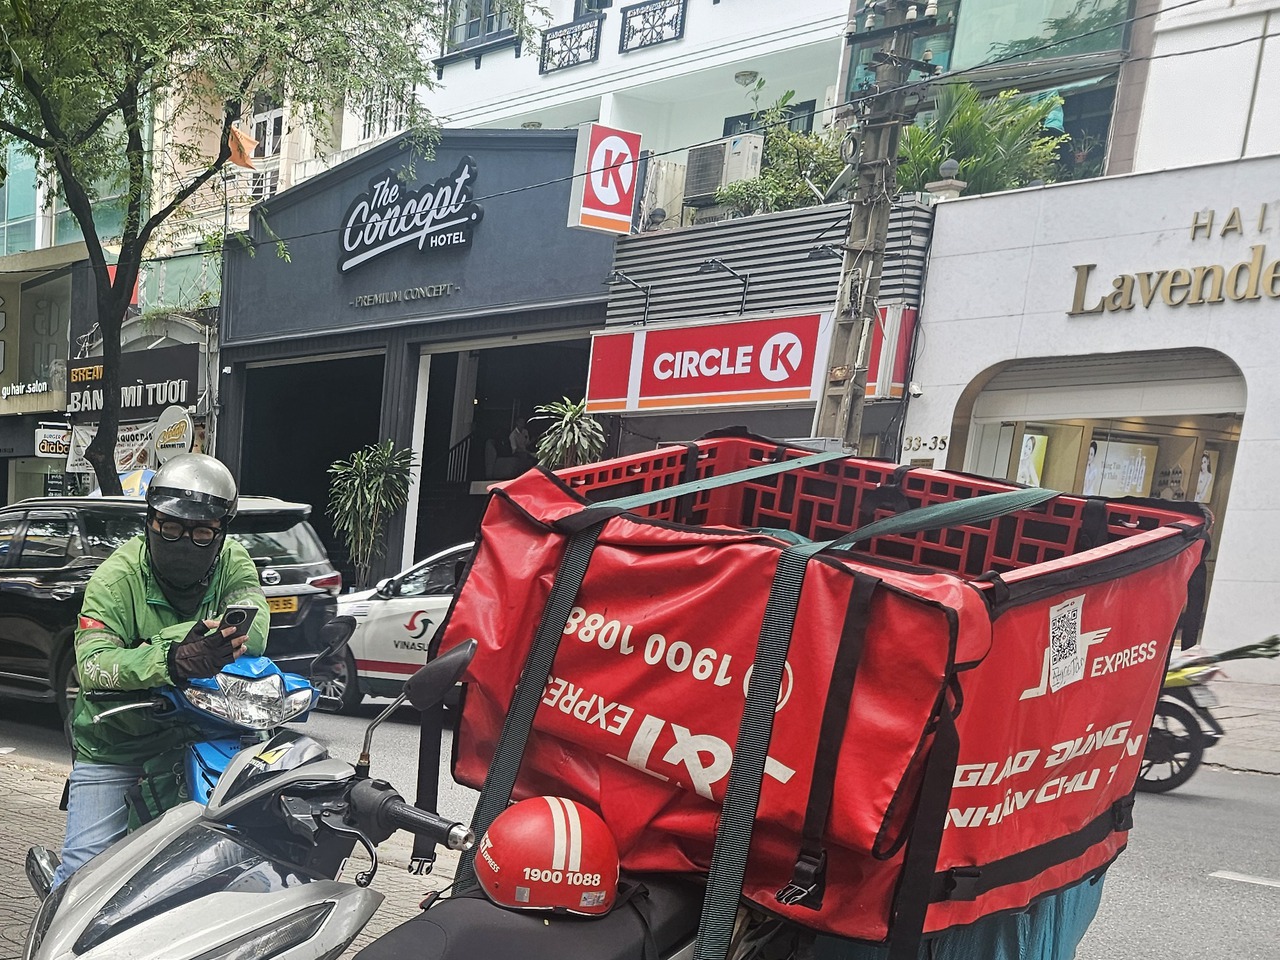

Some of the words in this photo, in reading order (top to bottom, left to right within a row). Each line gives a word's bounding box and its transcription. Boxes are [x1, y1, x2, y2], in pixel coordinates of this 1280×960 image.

[371, 177, 400, 210] The
[597, 146, 632, 206] K
[343, 164, 471, 251] Concept
[1190, 203, 1278, 240] HAI
[430, 231, 466, 248] HOTEL
[403, 282, 453, 300] CONCEPT
[652, 345, 754, 381] CIRCLE
[763, 338, 800, 381] K
[1, 385, 11, 399] gu
[11, 382, 26, 397] hair
[70, 385, 104, 413] BÁN
[903, 436, 948, 452] 33-35
[393, 640, 429, 652] VINASU
[564, 606, 634, 655] 1088
[644, 633, 732, 687] 1900
[1090, 640, 1157, 678] EXPRESS
[522, 670, 635, 736] EXPRES
[952, 749, 1041, 788] GIAO
[482, 851, 501, 873] EXPRESS
[523, 867, 563, 884] 1900
[565, 872, 601, 887] 1088
